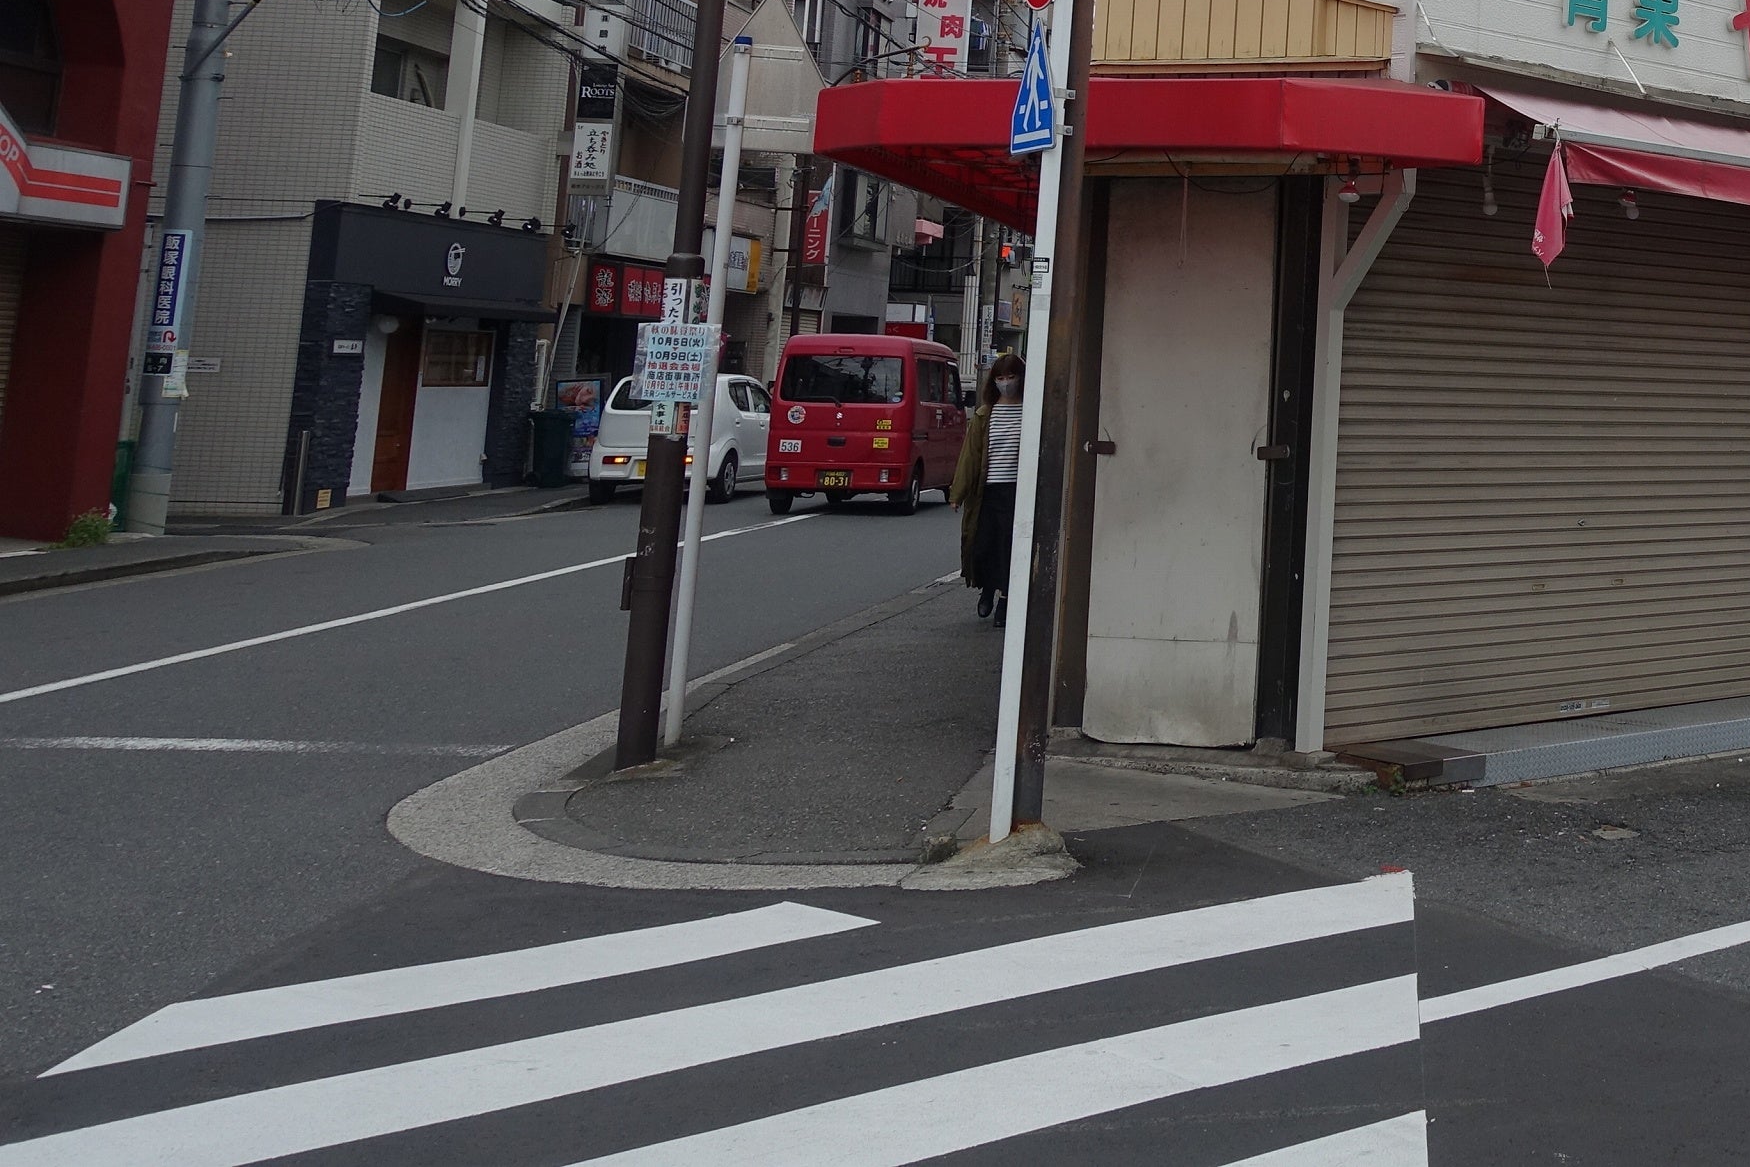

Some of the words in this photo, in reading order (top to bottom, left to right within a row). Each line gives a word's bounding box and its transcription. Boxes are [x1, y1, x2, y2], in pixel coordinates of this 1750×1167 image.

[0, 129, 19, 162] OP
[153, 234, 182, 326] 飯塚眼科医院
[651, 336, 705, 348] 10月5日(火)
[649, 351, 703, 362] 10月9日(土)
[781, 442, 799, 452] 536
[823, 477, 849, 486] 80-31
